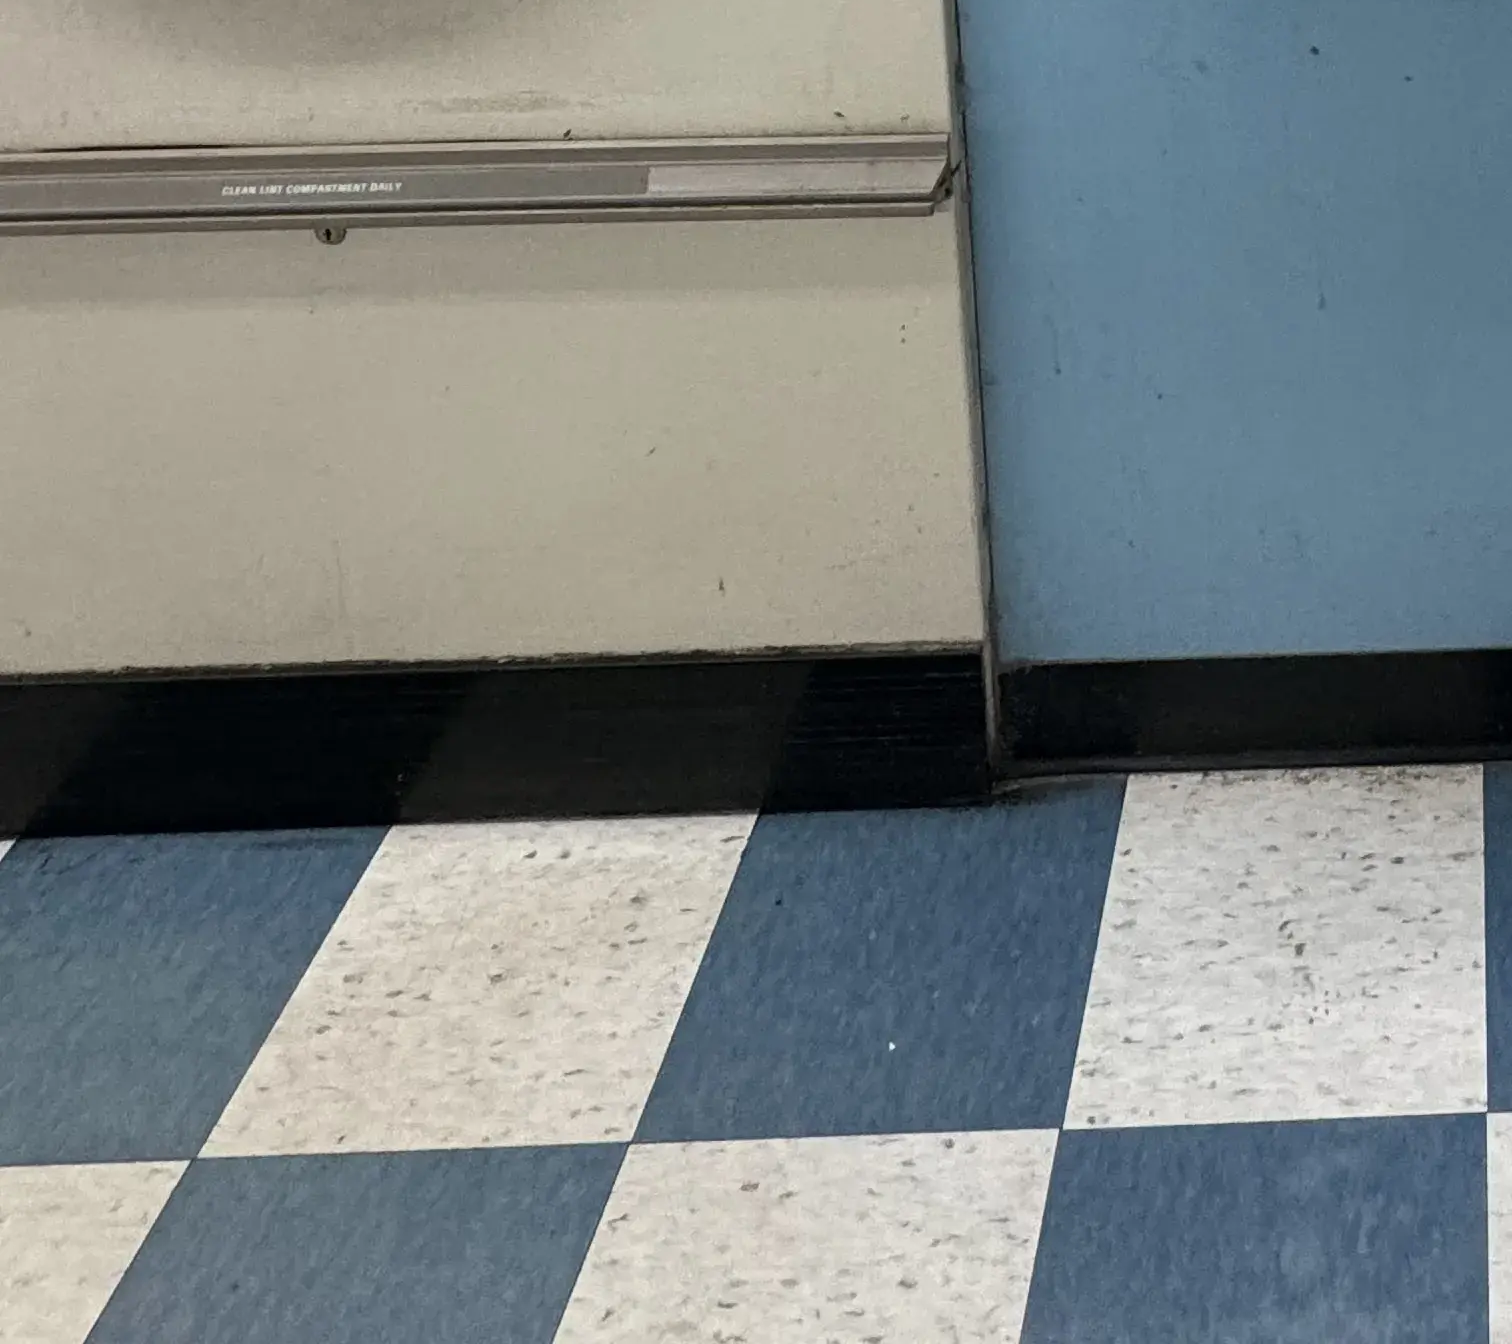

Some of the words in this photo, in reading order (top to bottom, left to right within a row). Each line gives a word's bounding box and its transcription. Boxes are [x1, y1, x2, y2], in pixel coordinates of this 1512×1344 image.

[221, 185, 257, 196] CLEAN
[259, 185, 282, 195] LINT
[286, 183, 367, 195] COMPARTMENT
[369, 182, 402, 193] DAILY
